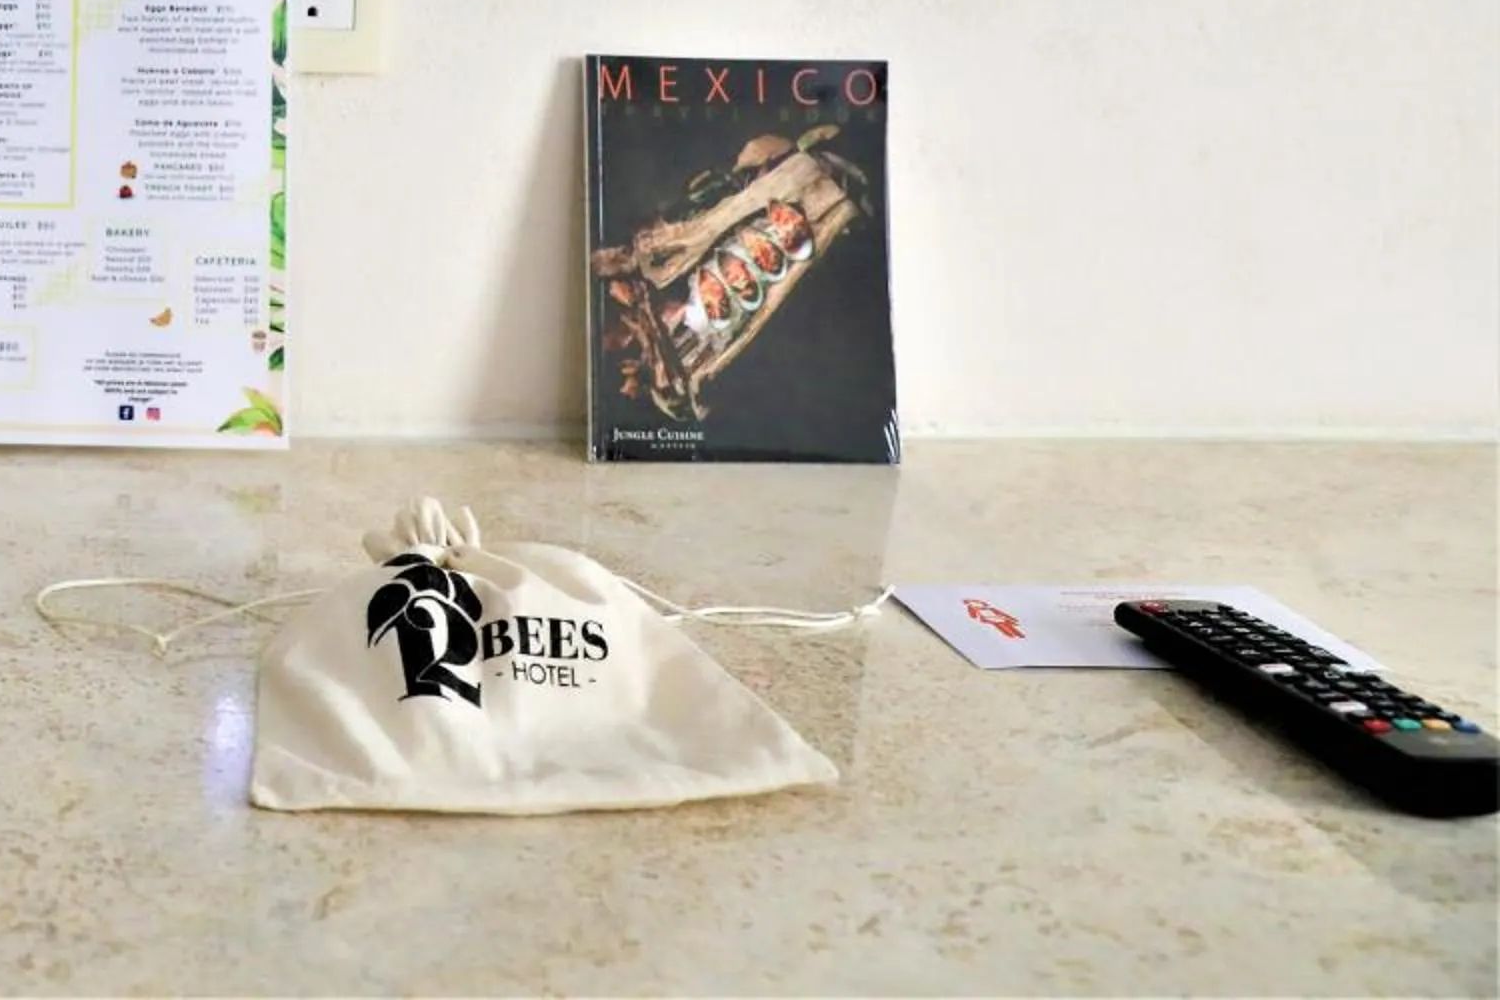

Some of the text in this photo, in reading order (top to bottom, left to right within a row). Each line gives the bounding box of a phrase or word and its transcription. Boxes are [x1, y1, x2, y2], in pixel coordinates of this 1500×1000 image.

[144, 4, 167, 13] Eggs
[598, 64, 878, 106] MEXICO
[105, 227, 150, 238] BAKERY
[195, 256, 257, 267] CAFETERIA
[612, 427, 705, 443] JUNGLE CUISINE
[481, 615, 610, 662] BEES
[512, 661, 581, 687] HOTEL
